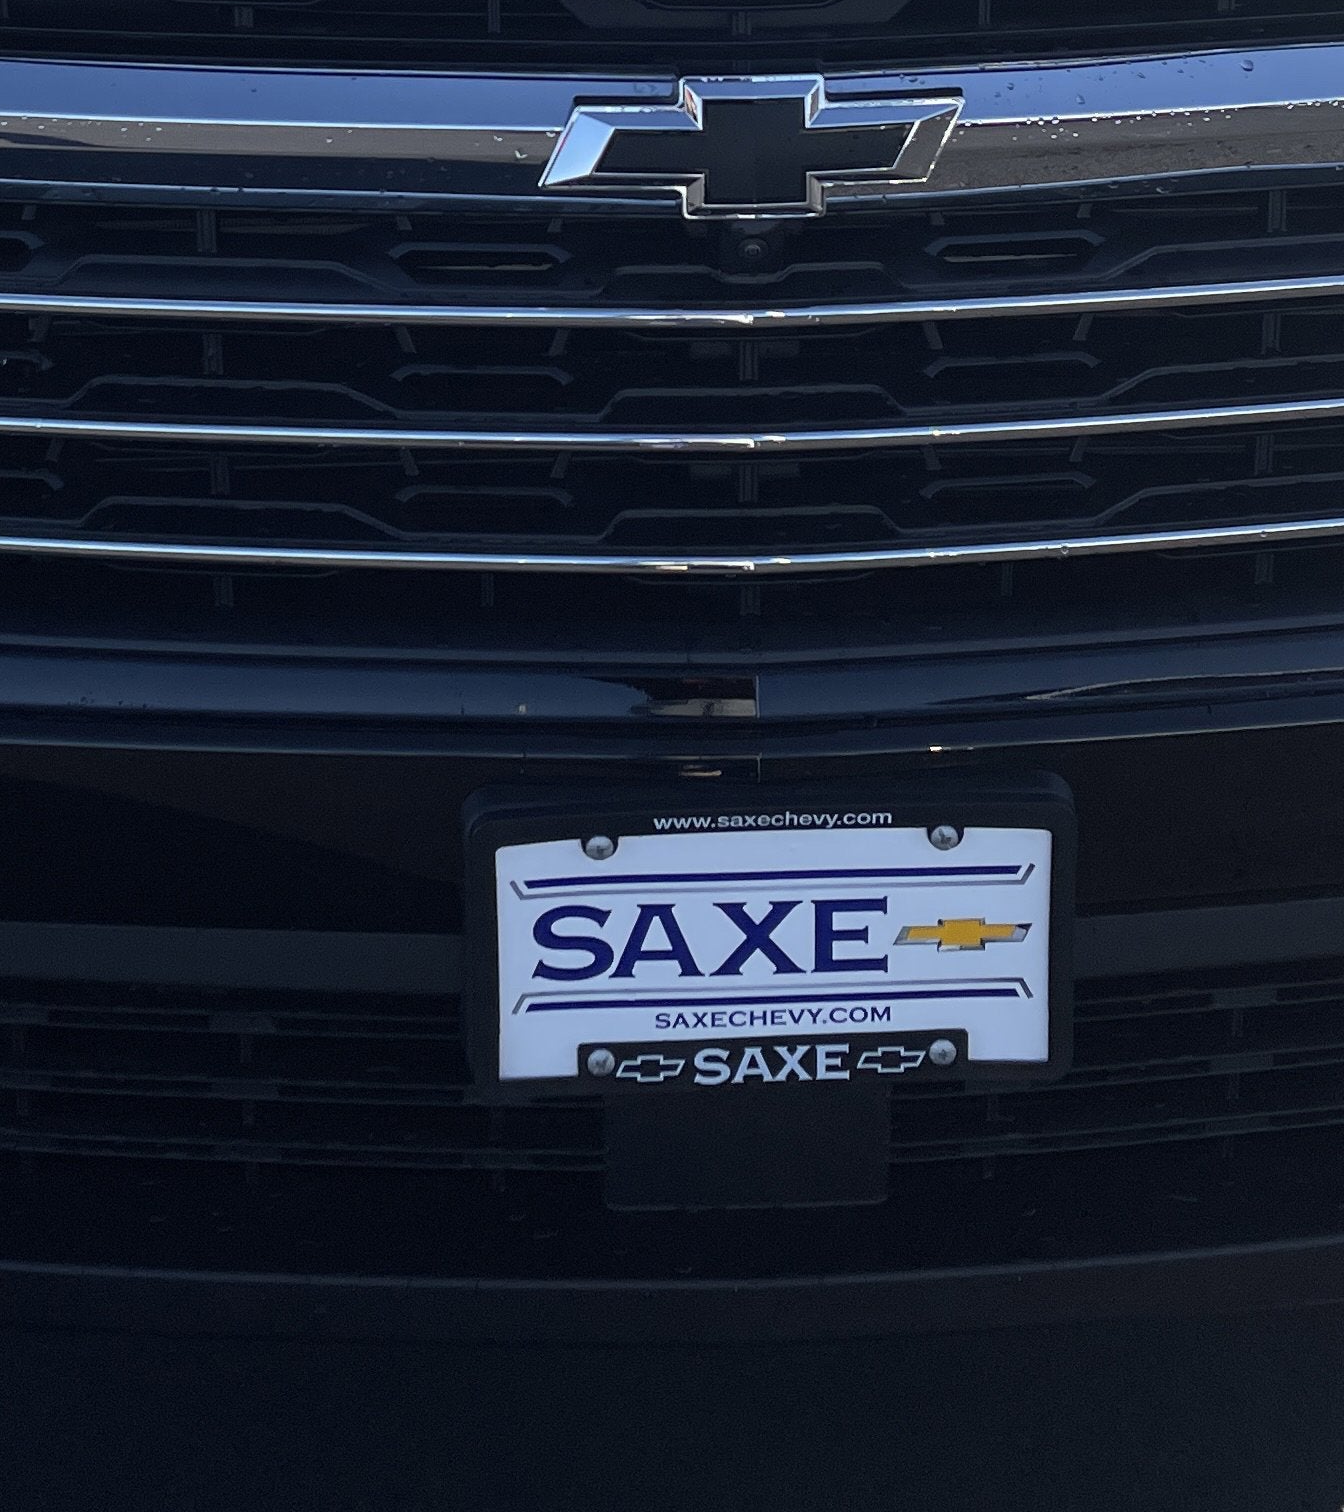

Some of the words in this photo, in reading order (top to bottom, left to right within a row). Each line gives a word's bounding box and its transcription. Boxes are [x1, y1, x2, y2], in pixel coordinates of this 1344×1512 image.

[653, 811, 893, 830] www.saxechevy.com
[531, 896, 889, 982] SAXE
[655, 1006, 893, 1030] SAXECHEVY.COM
[693, 1043, 851, 1086] SAXE
